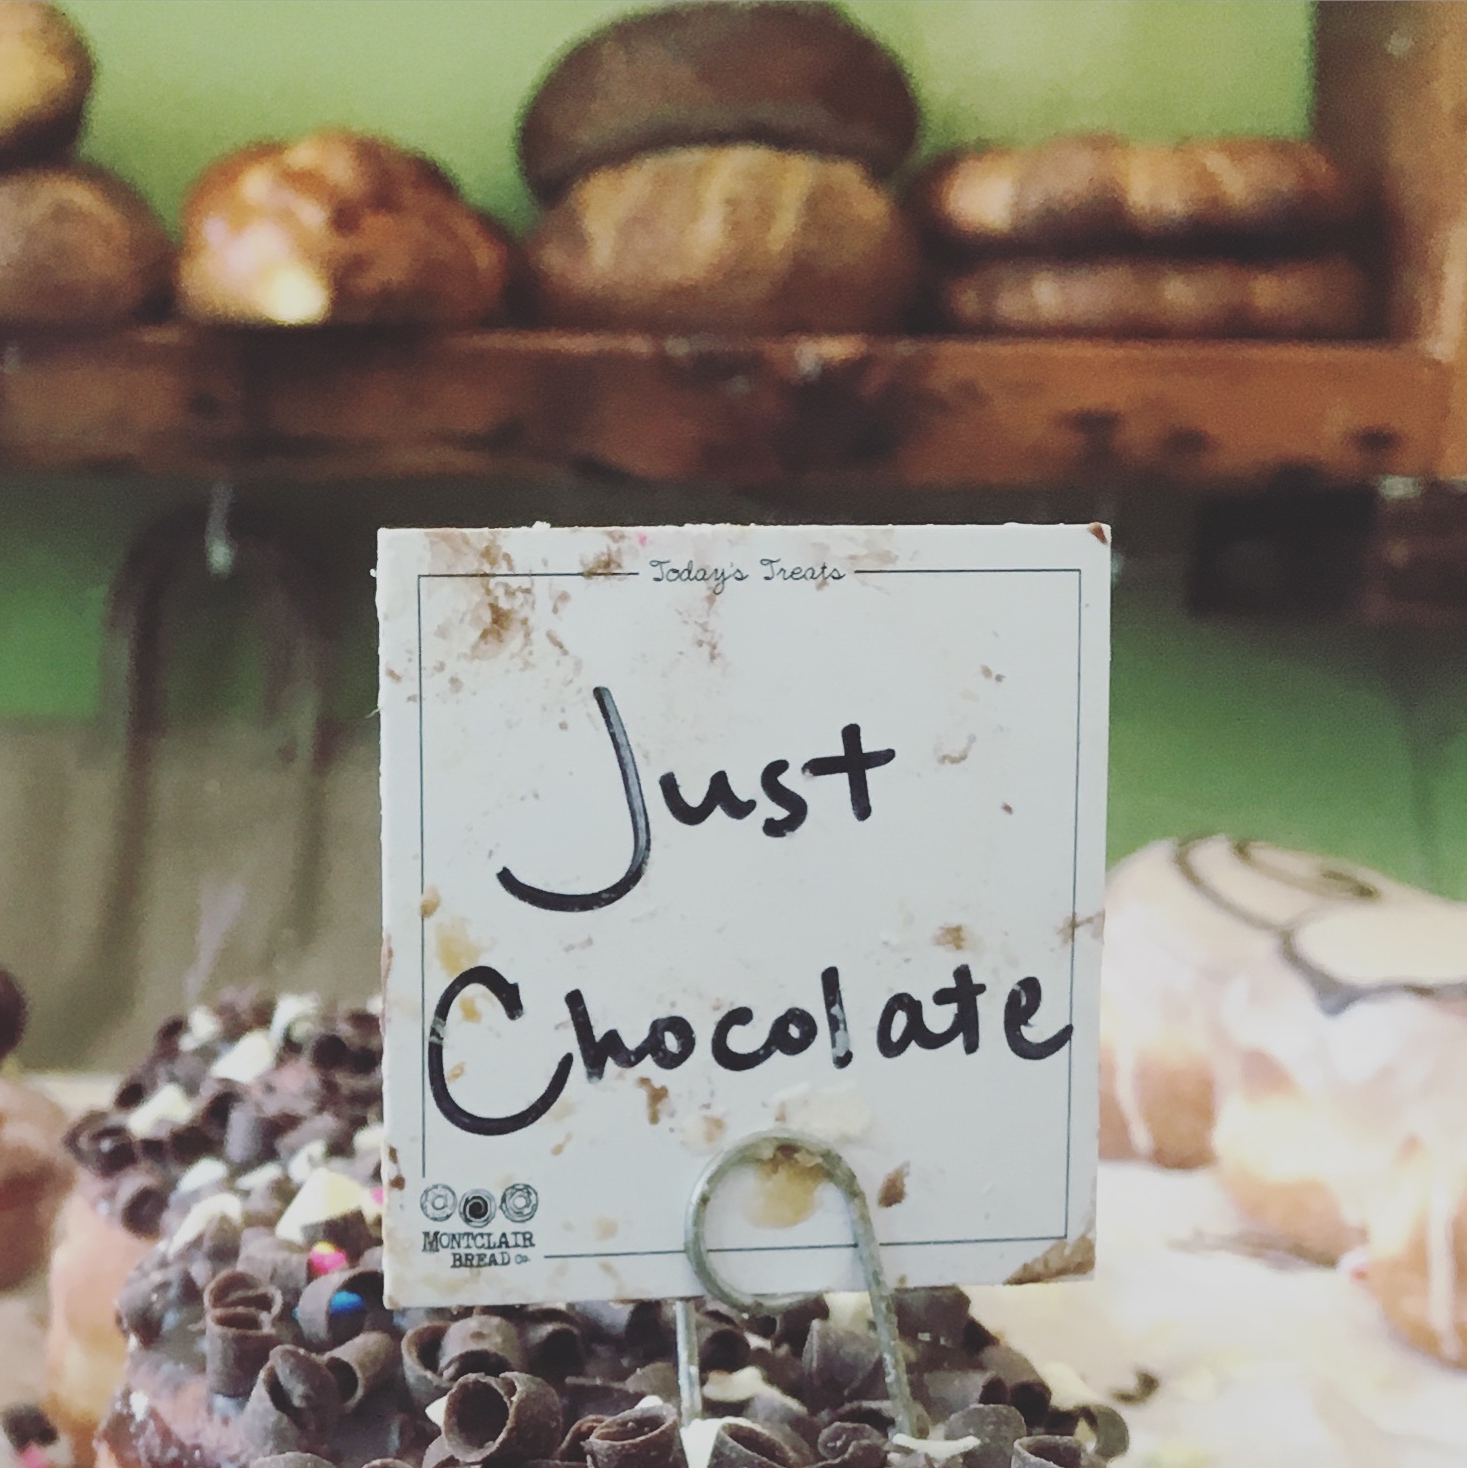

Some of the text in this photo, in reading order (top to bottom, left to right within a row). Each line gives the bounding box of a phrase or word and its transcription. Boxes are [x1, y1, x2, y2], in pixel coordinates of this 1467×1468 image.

[649, 558, 846, 595] Today's Treats
[496, 686, 897, 913] Just
[427, 964, 1074, 1137] Chocolate
[421, 1231, 535, 1252] MONTCLAIR
[450, 1252, 511, 1268] BREAD
